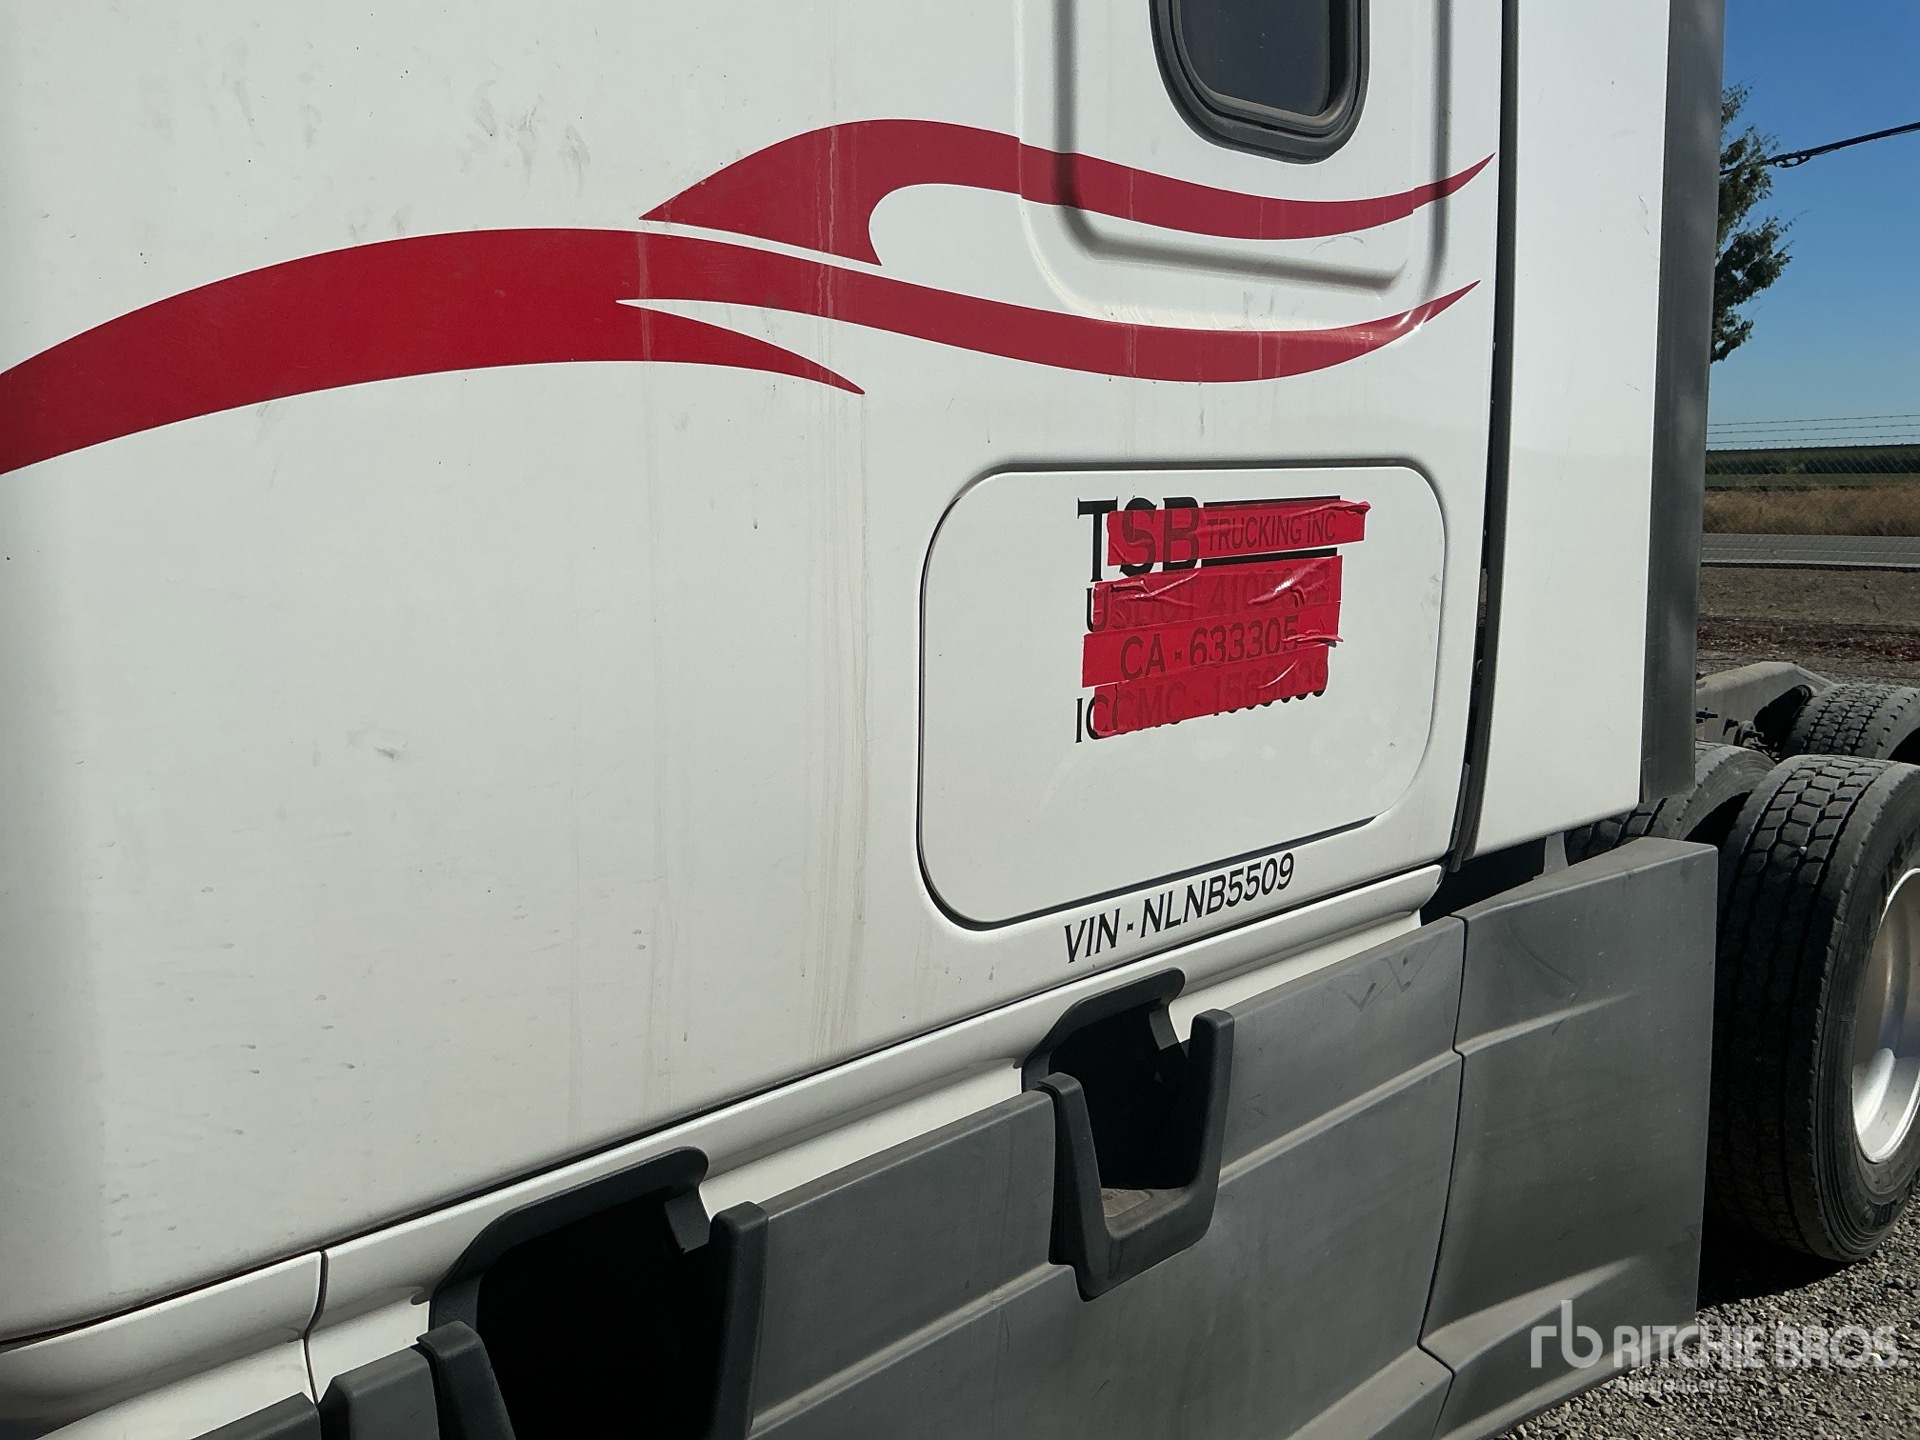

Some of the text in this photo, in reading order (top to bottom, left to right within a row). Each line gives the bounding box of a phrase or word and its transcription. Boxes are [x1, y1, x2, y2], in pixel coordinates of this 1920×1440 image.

[1077, 496, 1337, 583] TSB TRUCKING INC
